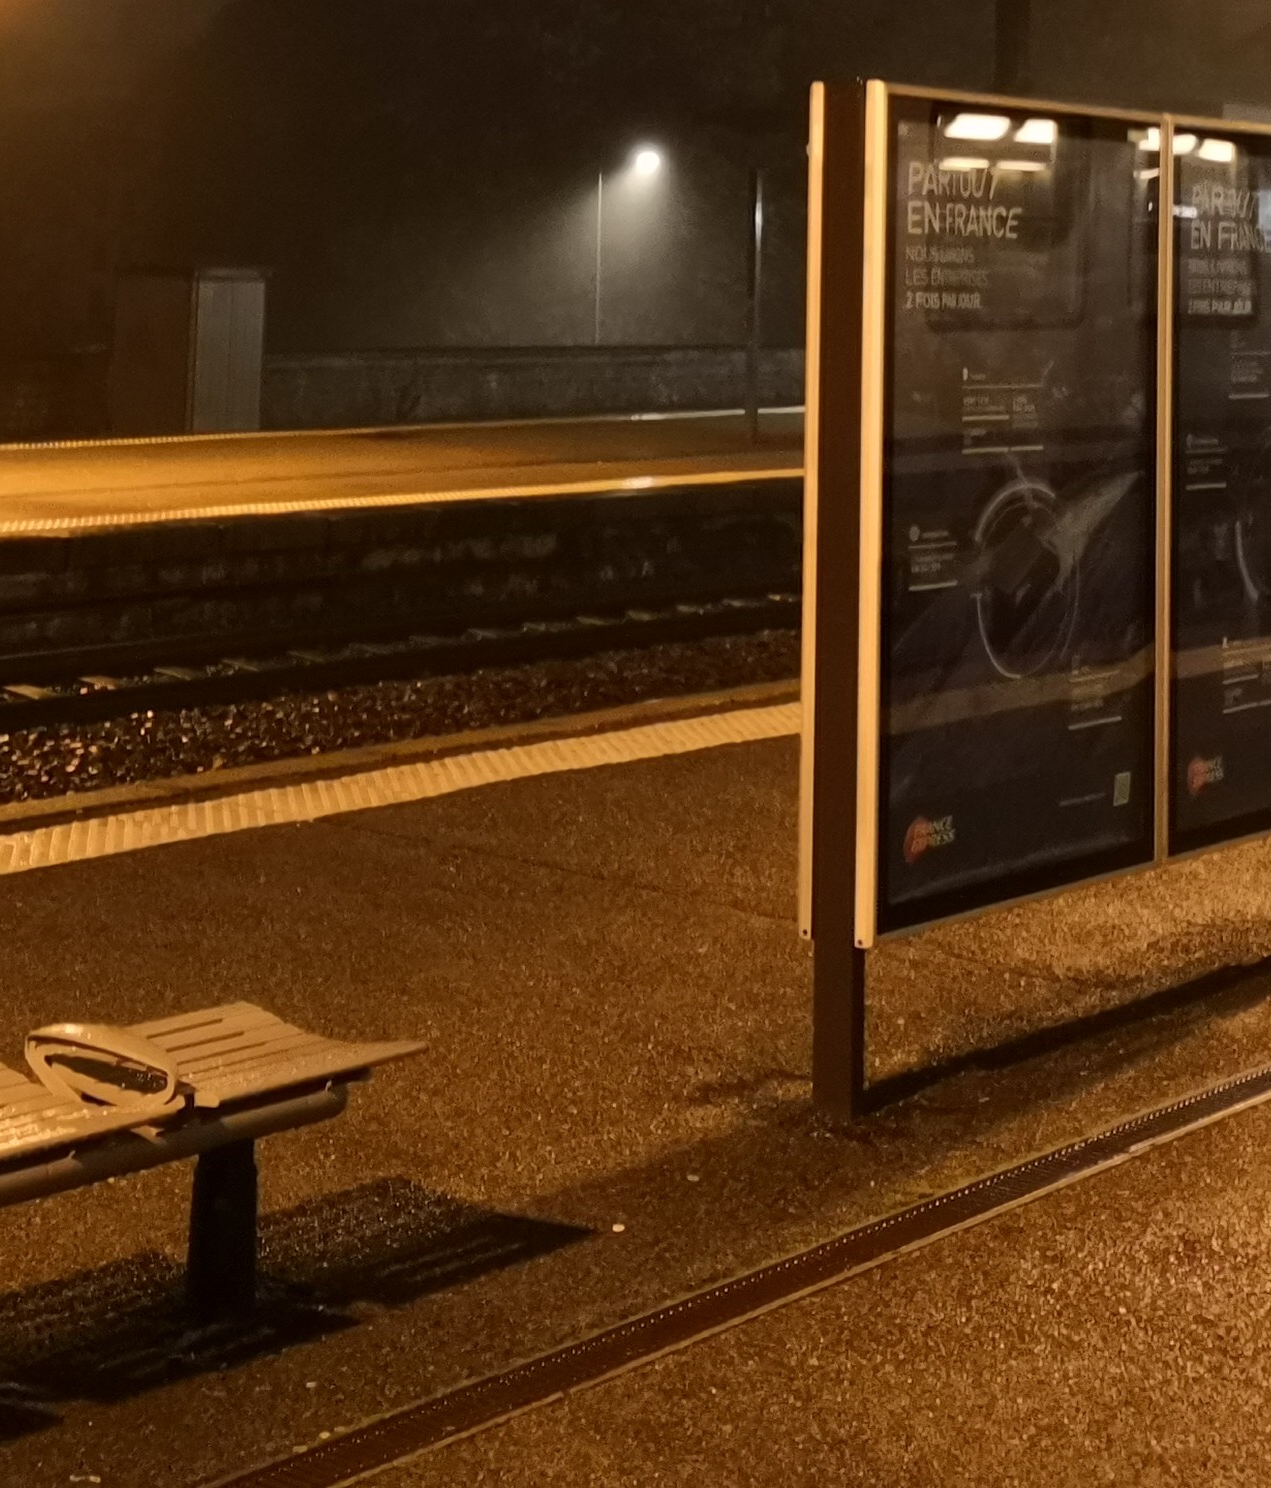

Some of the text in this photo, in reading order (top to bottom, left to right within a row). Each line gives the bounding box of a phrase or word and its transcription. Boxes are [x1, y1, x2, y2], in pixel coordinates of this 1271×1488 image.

[907, 160, 1001, 201] PARTOUT
[907, 200, 1023, 239] EN FRANCE
